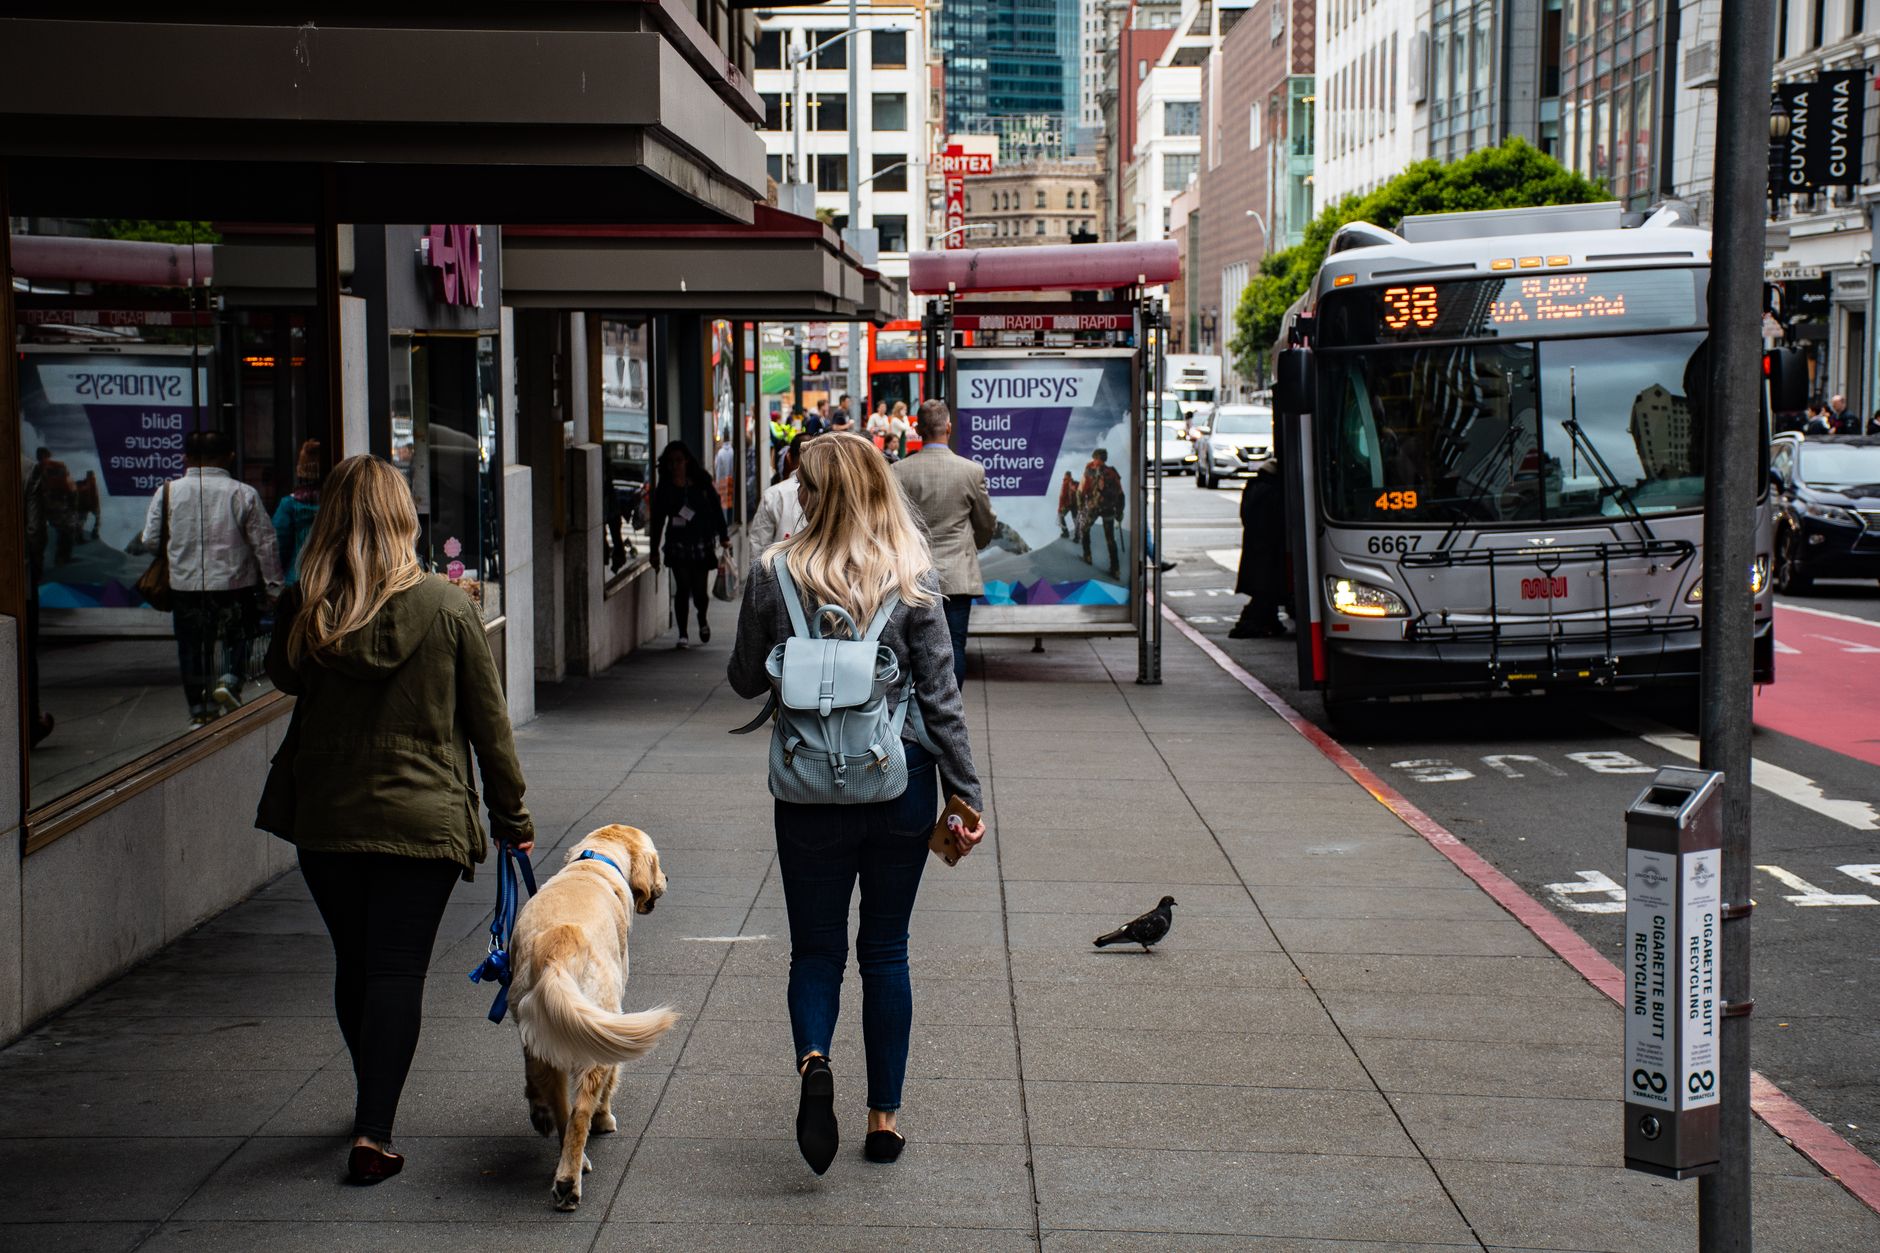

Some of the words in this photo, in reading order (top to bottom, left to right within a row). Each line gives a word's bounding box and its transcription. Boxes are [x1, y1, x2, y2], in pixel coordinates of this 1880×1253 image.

[1024, 114, 1049, 129] THE
[1830, 79, 1850, 177] CUYANA
[1010, 131, 1062, 146] PALACE
[1789, 91, 1809, 185] CUYANA
[932, 155, 991, 174] BRITEX
[1765, 268, 1818, 278] POWELL
[1384, 286, 1438, 328] 38
[1007, 316, 1043, 330] RAPID
[1081, 316, 1117, 330] RAPID
[971, 376, 1078, 403] SYNOPSYS
[971, 415, 1011, 432] Build
[971, 435, 1028, 451] Secure
[971, 454, 1044, 470] Software
[984, 475, 1022, 489] aster
[1368, 535, 1422, 554] 6667
[1652, 915, 1665, 997] CIGARETTE
[1703, 913, 1713, 995] CIGARETTE
[1635, 932, 1647, 1016] RECYCLING
[1689, 936, 1699, 1020] RECYCLING
[1652, 1001, 1664, 1040] BUTT
[1703, 999, 1712, 1037] BUTT
[1632, 1090, 1668, 1102] TERRACYCLE
[1688, 1092, 1715, 1102] TERRACYCLE
